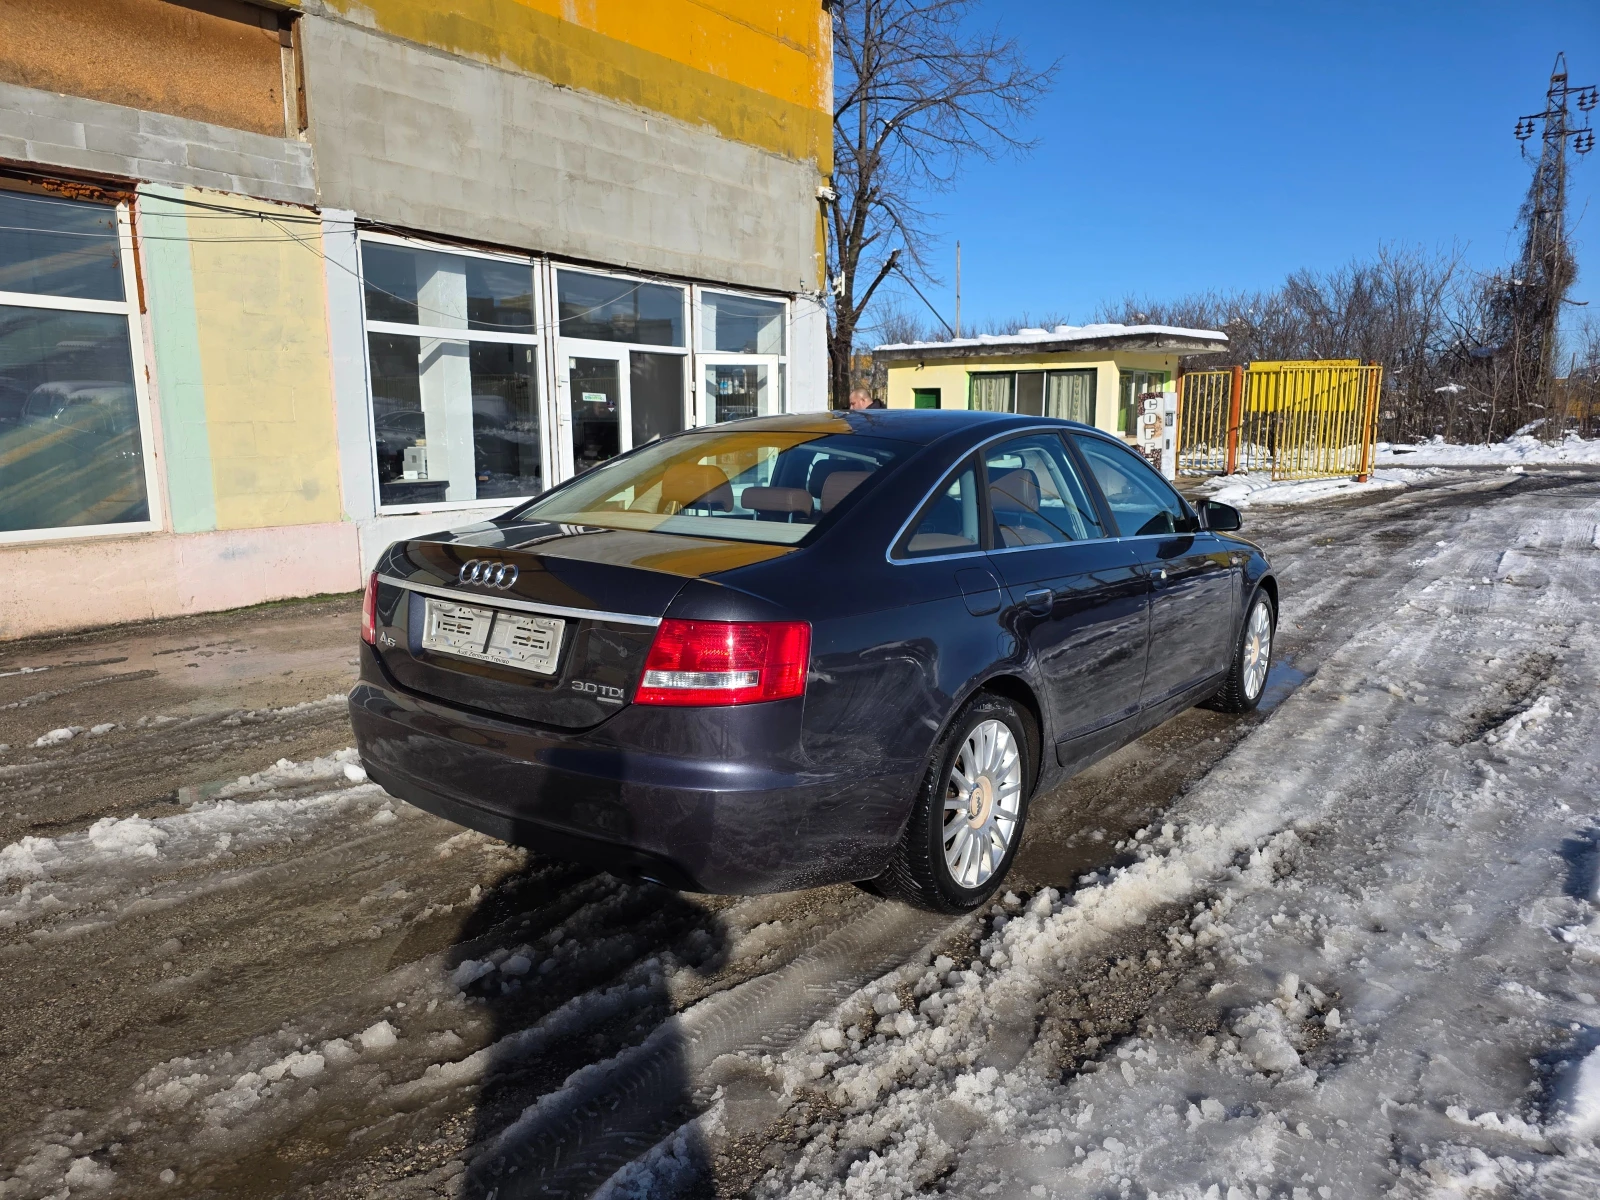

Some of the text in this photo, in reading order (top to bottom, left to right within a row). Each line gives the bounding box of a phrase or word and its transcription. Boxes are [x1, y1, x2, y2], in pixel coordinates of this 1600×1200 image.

[379, 631, 396, 647] A6
[571, 680, 625, 698] 3.0 TDI
